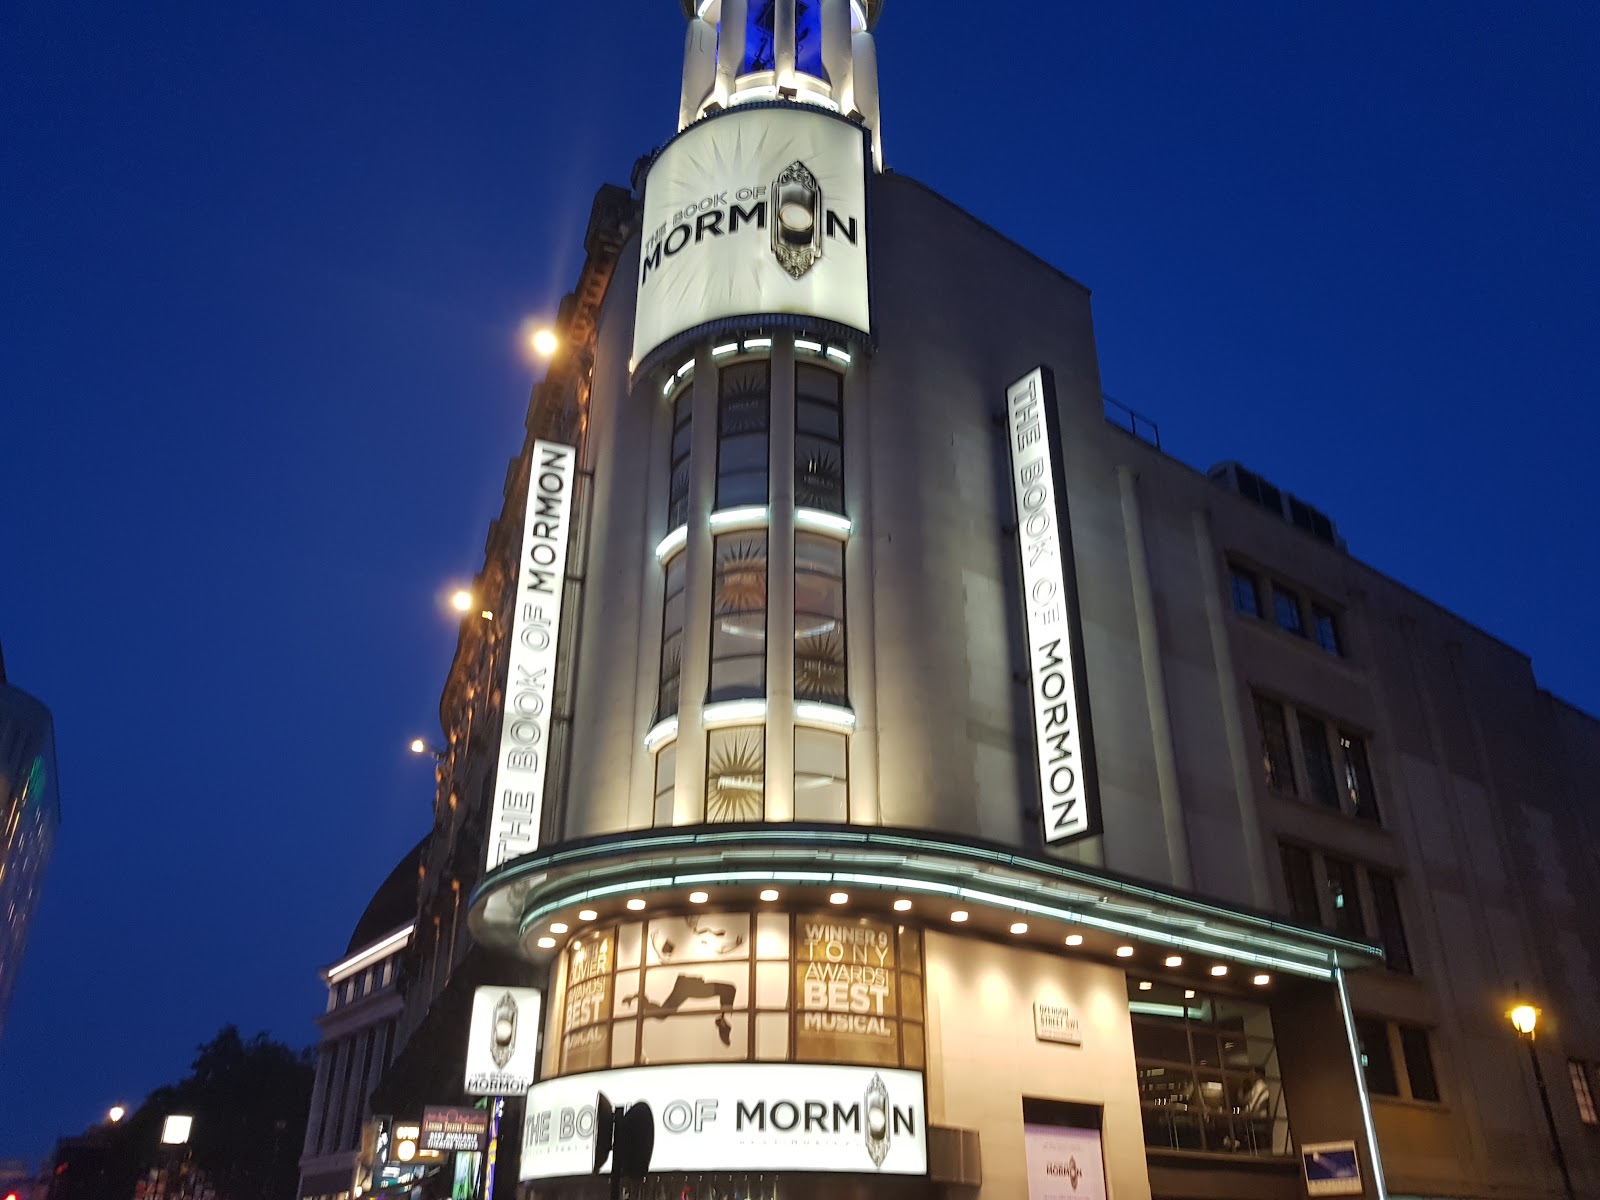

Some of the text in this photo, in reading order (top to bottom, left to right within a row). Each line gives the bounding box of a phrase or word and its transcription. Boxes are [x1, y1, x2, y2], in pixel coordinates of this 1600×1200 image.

[645, 185, 767, 256] THE BOOK OF
[642, 200, 858, 288] MORMON
[1013, 378, 1079, 834] THE BOOK OF MORMON
[496, 446, 570, 867] THE BOOK OF MORMON
[803, 938, 889, 968] TONY
[804, 923, 888, 949] WINNER 9
[564, 994, 606, 1034] BEST
[804, 979, 890, 1016] BEST
[804, 1011, 891, 1037] MUSICAL
[525, 1110, 552, 1148] THE
[663, 1098, 719, 1134] OF
[735, 1099, 916, 1137] MORMON
